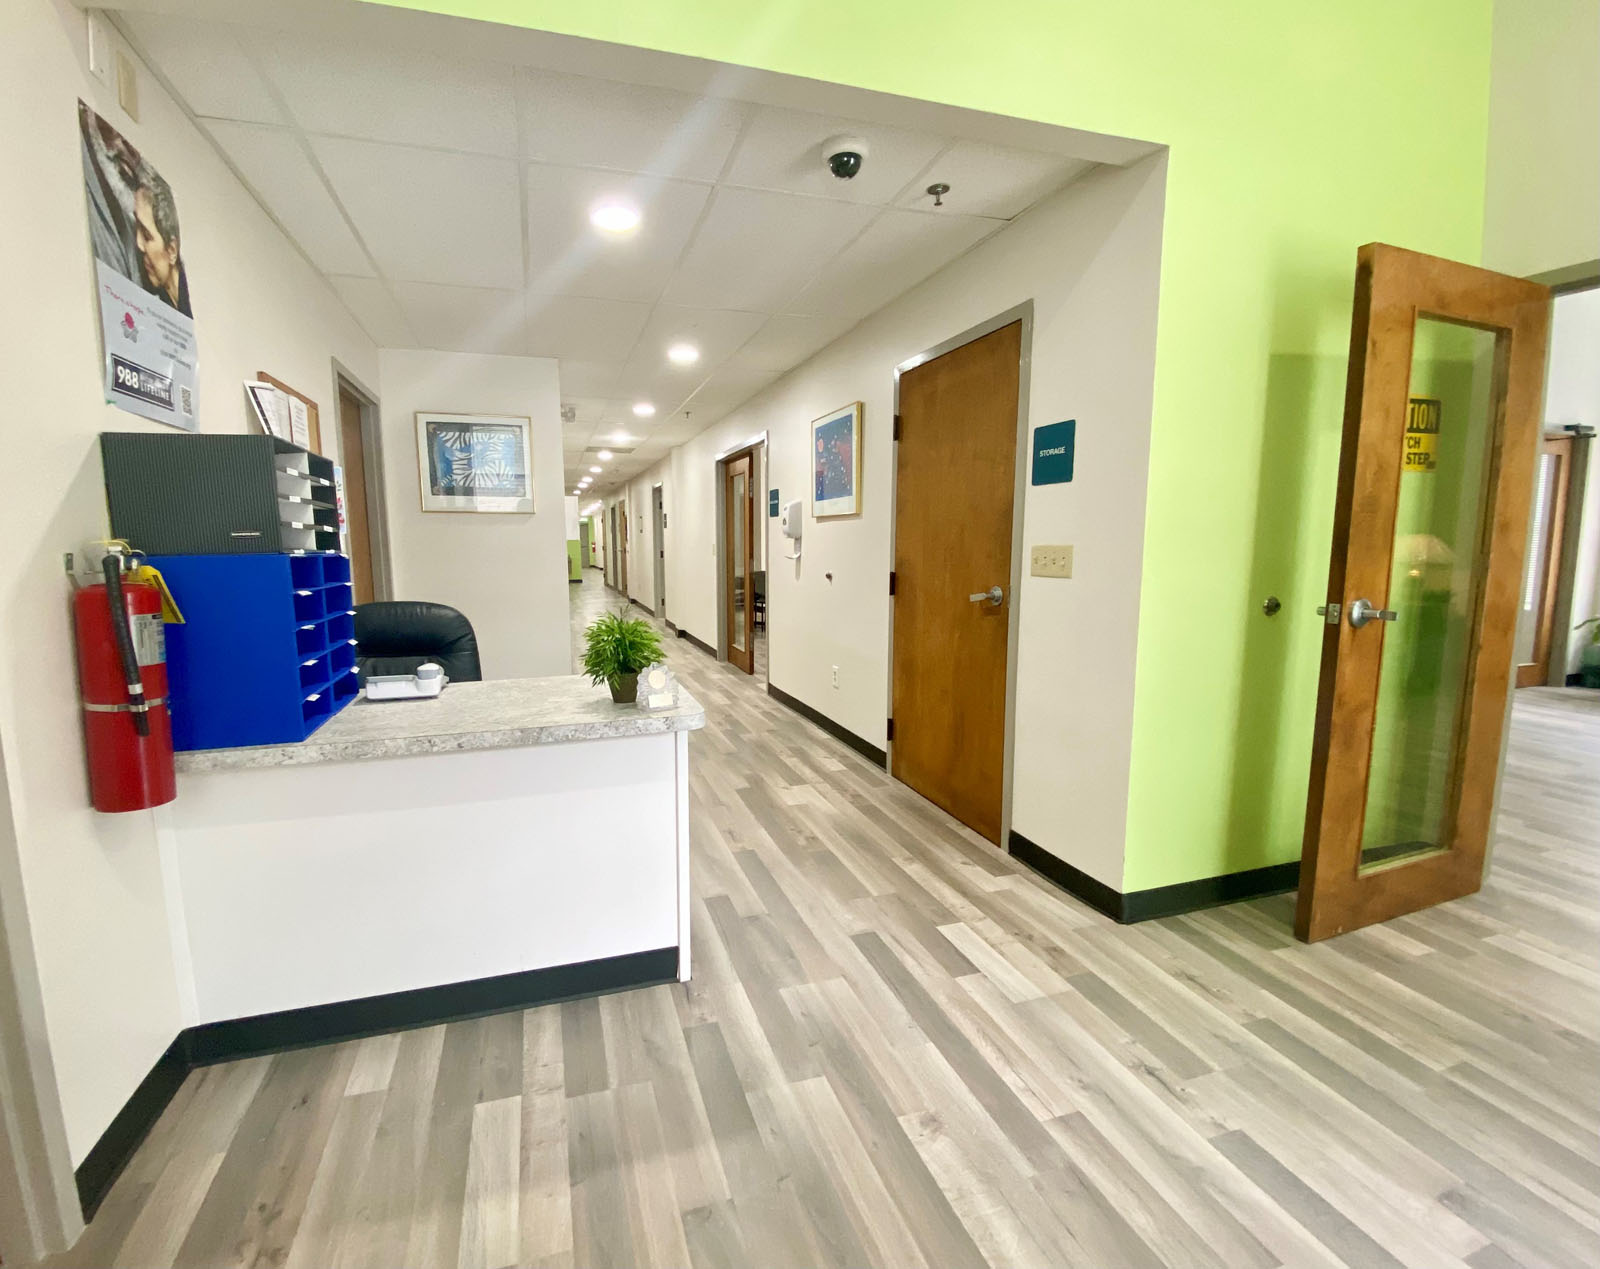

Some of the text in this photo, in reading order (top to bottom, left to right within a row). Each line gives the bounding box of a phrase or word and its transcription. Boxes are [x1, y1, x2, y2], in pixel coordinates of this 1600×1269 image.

[117, 365, 139, 389] 988
[140, 380, 170, 401] LIFELINE
[1405, 436, 1421, 449] CH
[1039, 446, 1066, 457] STORAGE
[1405, 452, 1431, 465] STEP
